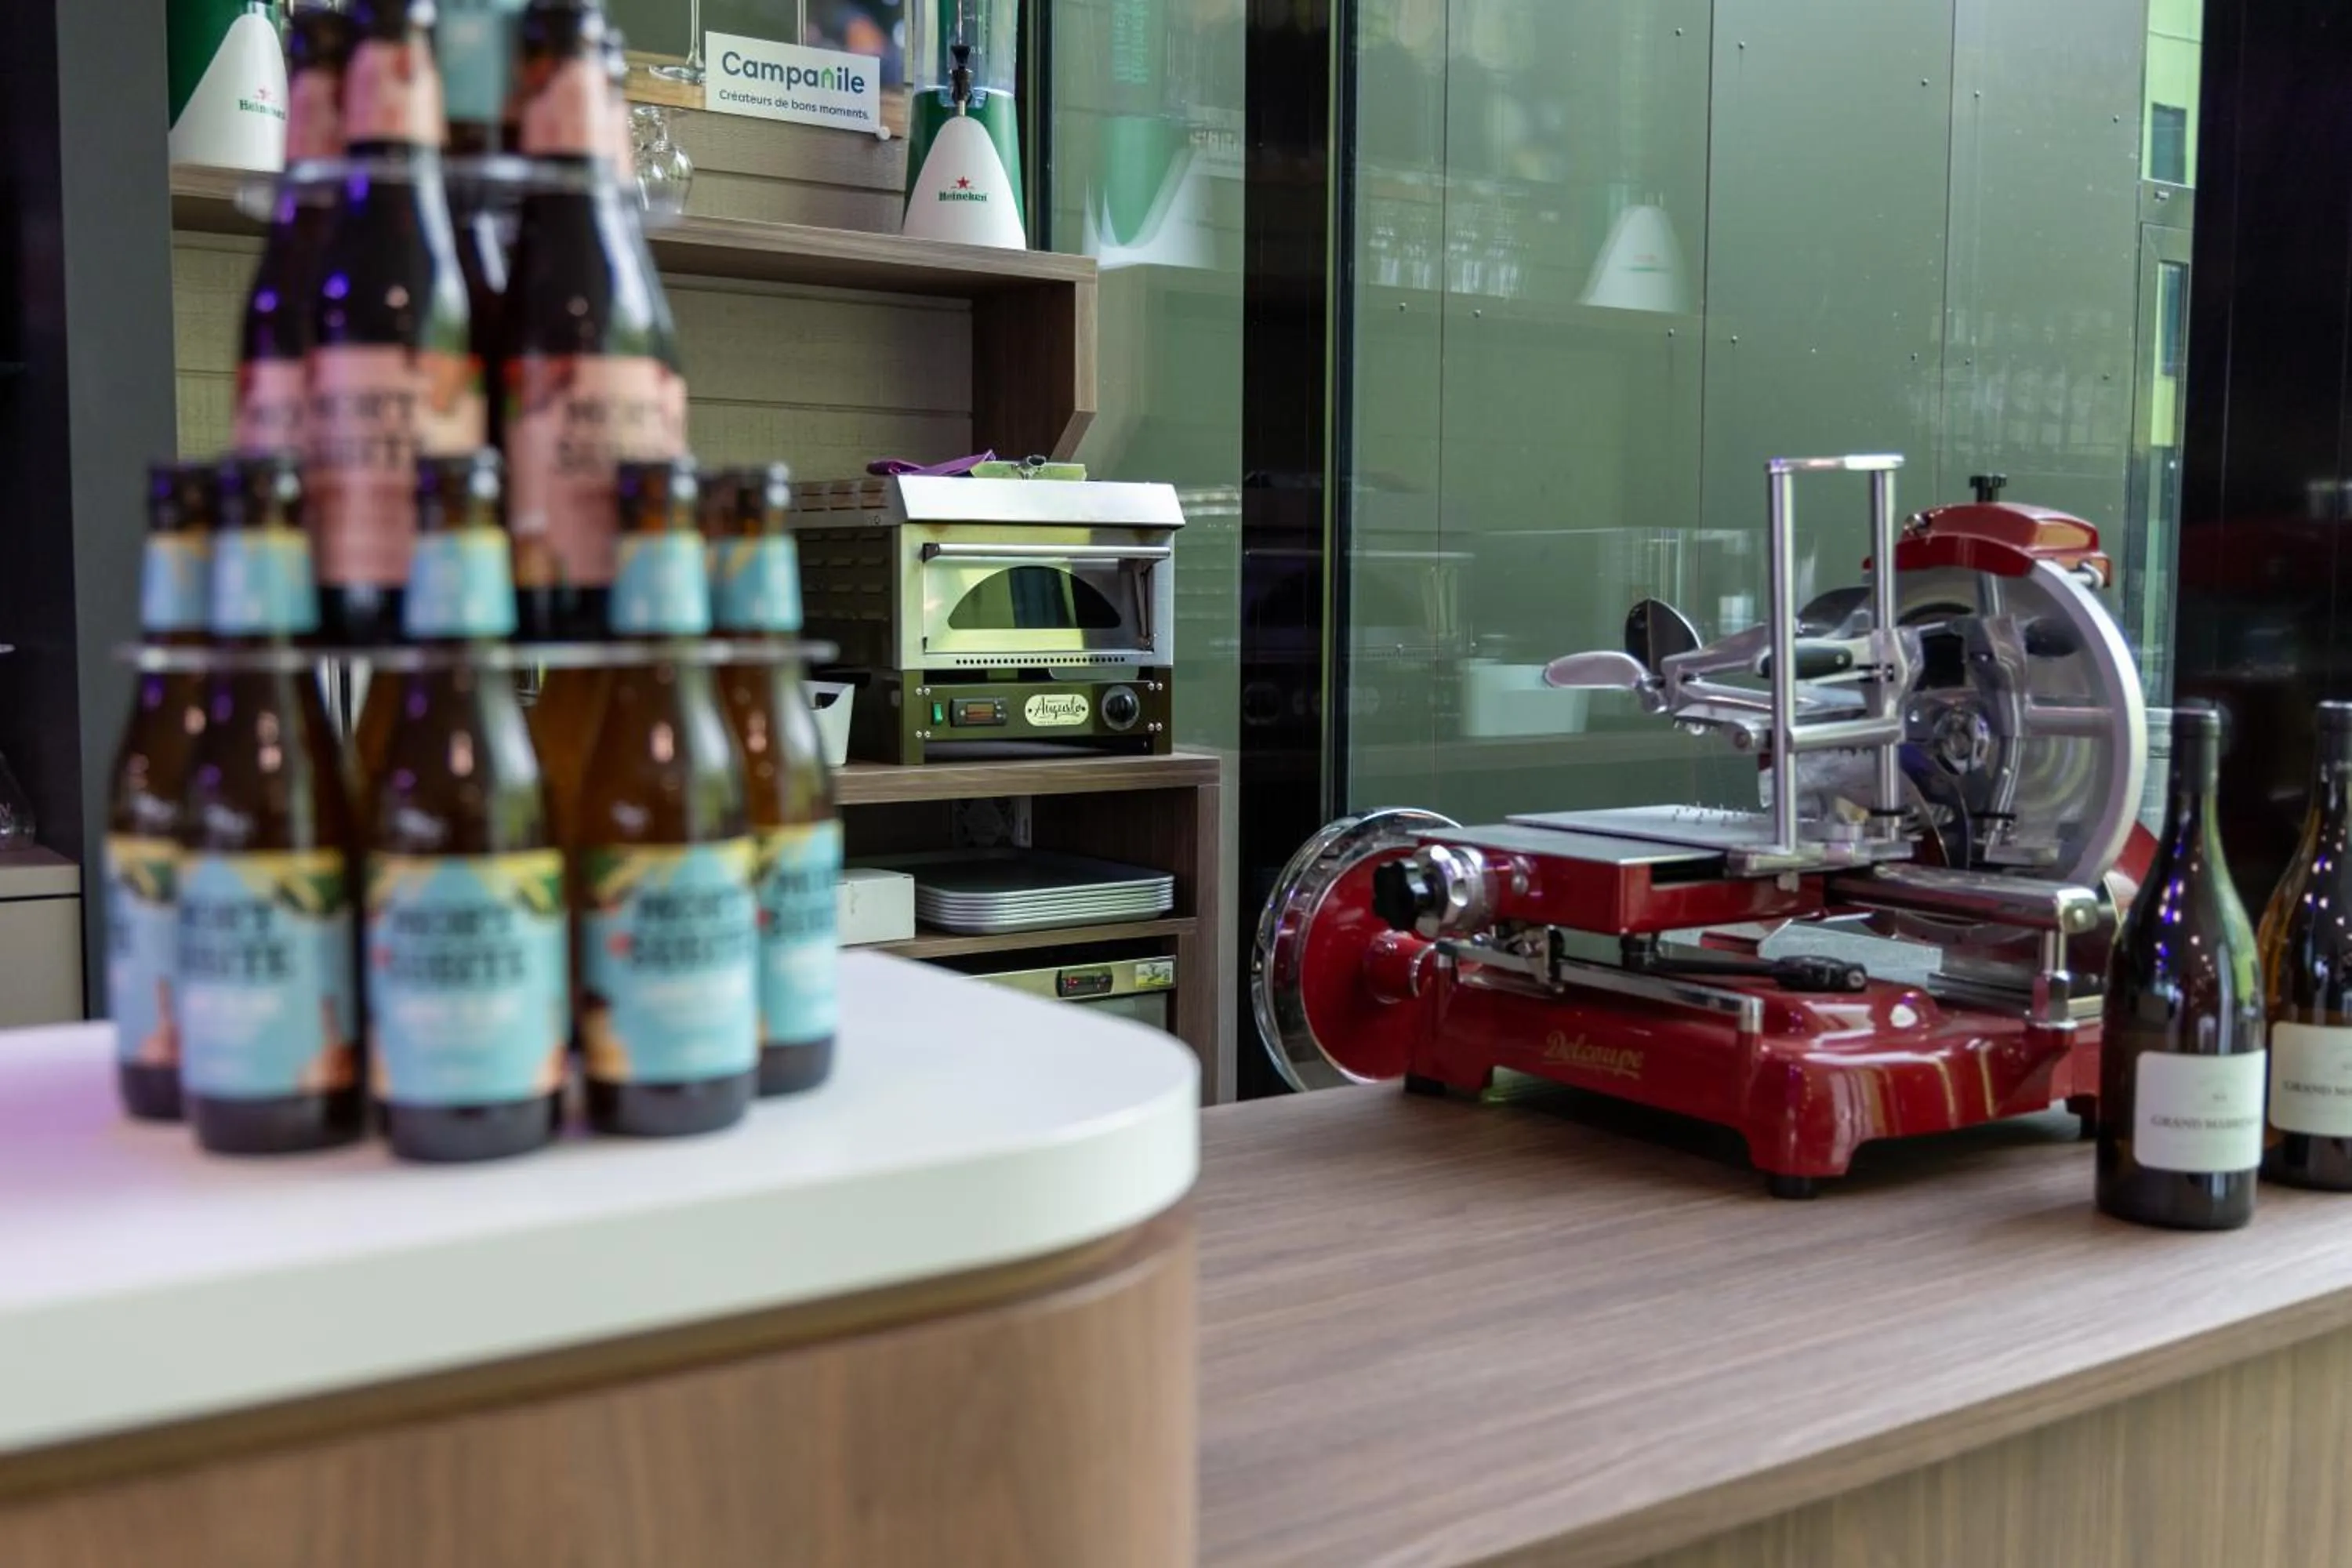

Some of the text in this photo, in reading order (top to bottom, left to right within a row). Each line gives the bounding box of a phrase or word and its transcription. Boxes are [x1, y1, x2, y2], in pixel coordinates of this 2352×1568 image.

[722, 51, 865, 93] Campanile
[719, 89, 772, 107] Créateurs
[774, 96, 789, 108] de
[791, 99, 817, 114] bons
[938, 191, 987, 202] Heineken
